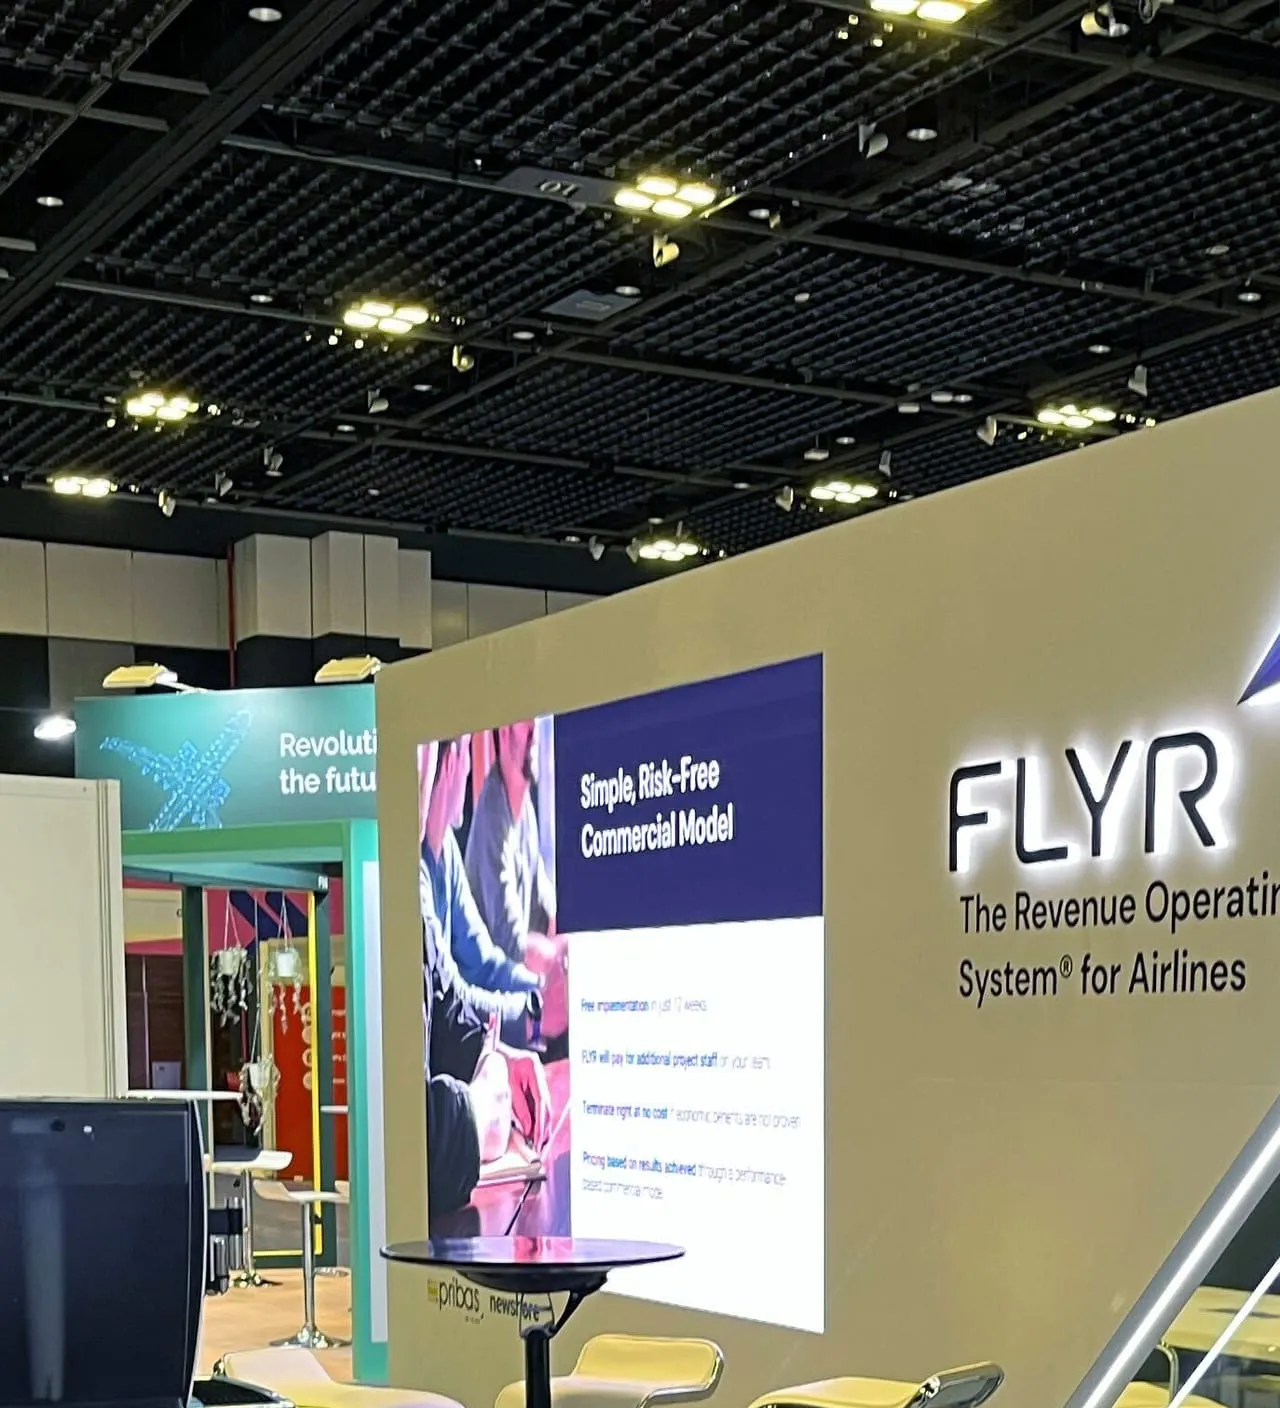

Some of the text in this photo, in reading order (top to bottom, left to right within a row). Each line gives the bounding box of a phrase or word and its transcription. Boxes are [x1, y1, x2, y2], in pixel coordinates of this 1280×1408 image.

[279, 767, 321, 794] the
[580, 755, 721, 813] Simple, Risk-Free
[949, 731, 1218, 872] FLYR
[580, 802, 734, 859] Commercial Model
[960, 894, 1007, 933] The
[1015, 891, 1137, 930] Revenue
[1081, 953, 1121, 994] for
[1129, 949, 1247, 994] Airlines
[439, 1277, 480, 1311] pribas
